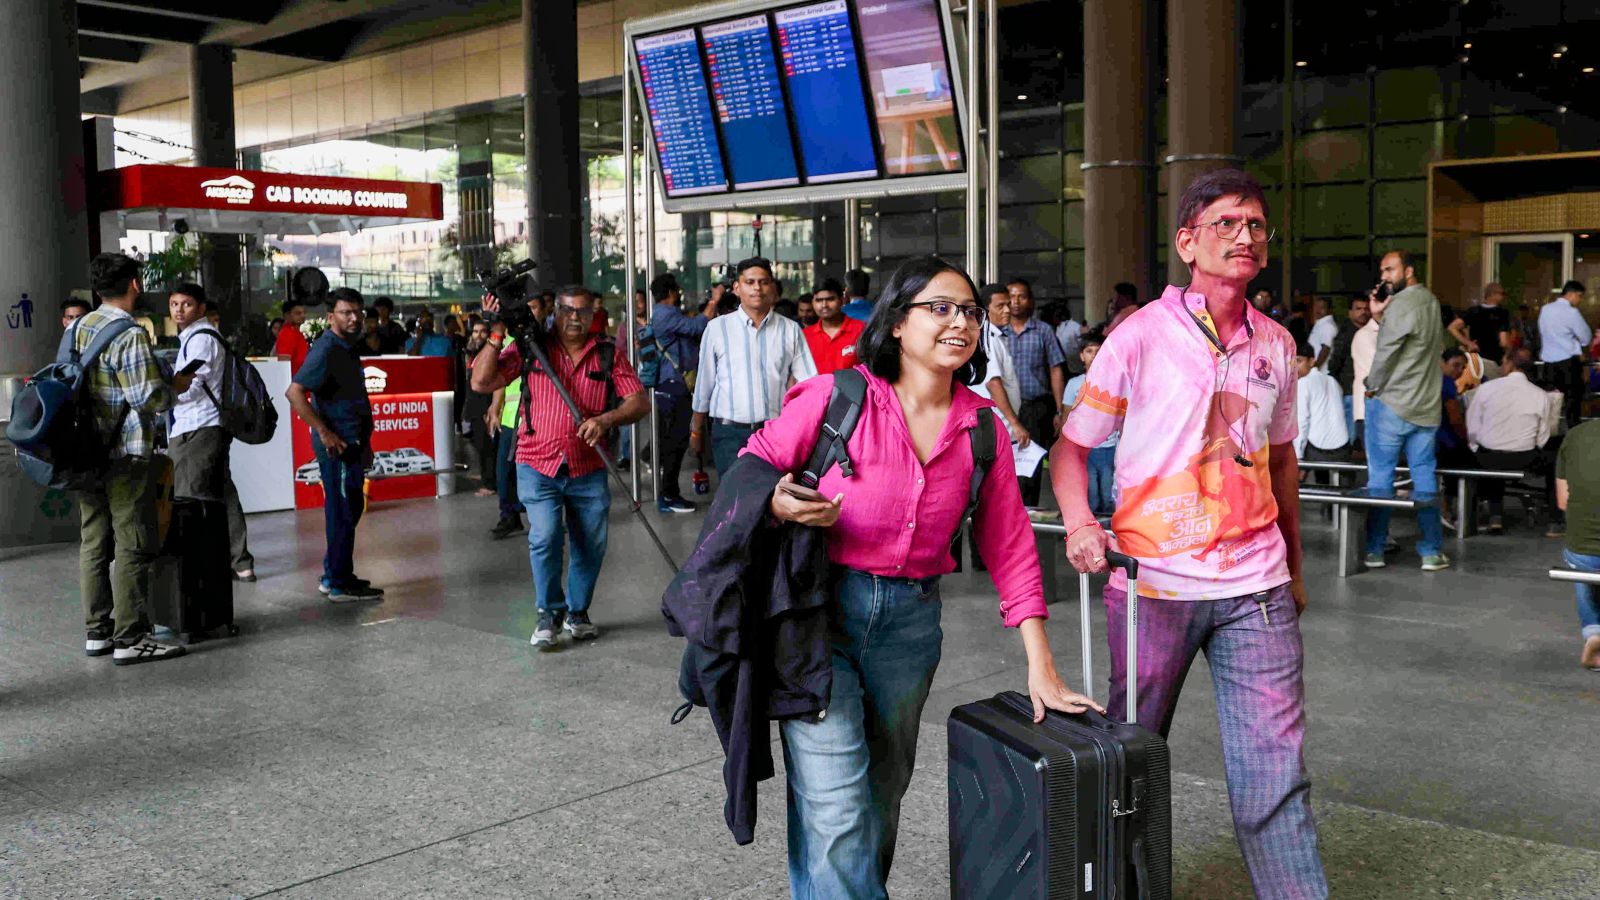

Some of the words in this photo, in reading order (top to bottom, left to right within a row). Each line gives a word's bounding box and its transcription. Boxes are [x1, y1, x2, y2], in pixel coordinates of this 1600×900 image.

[807, 6, 823, 15] Arrival
[266, 186, 292, 203] CAB
[293, 187, 353, 206] BOOKING
[354, 191, 408, 209] COUNTER
[382, 402, 396, 414] OF
[399, 401, 428, 414] INDIA
[374, 418, 419, 432] SERVICES
